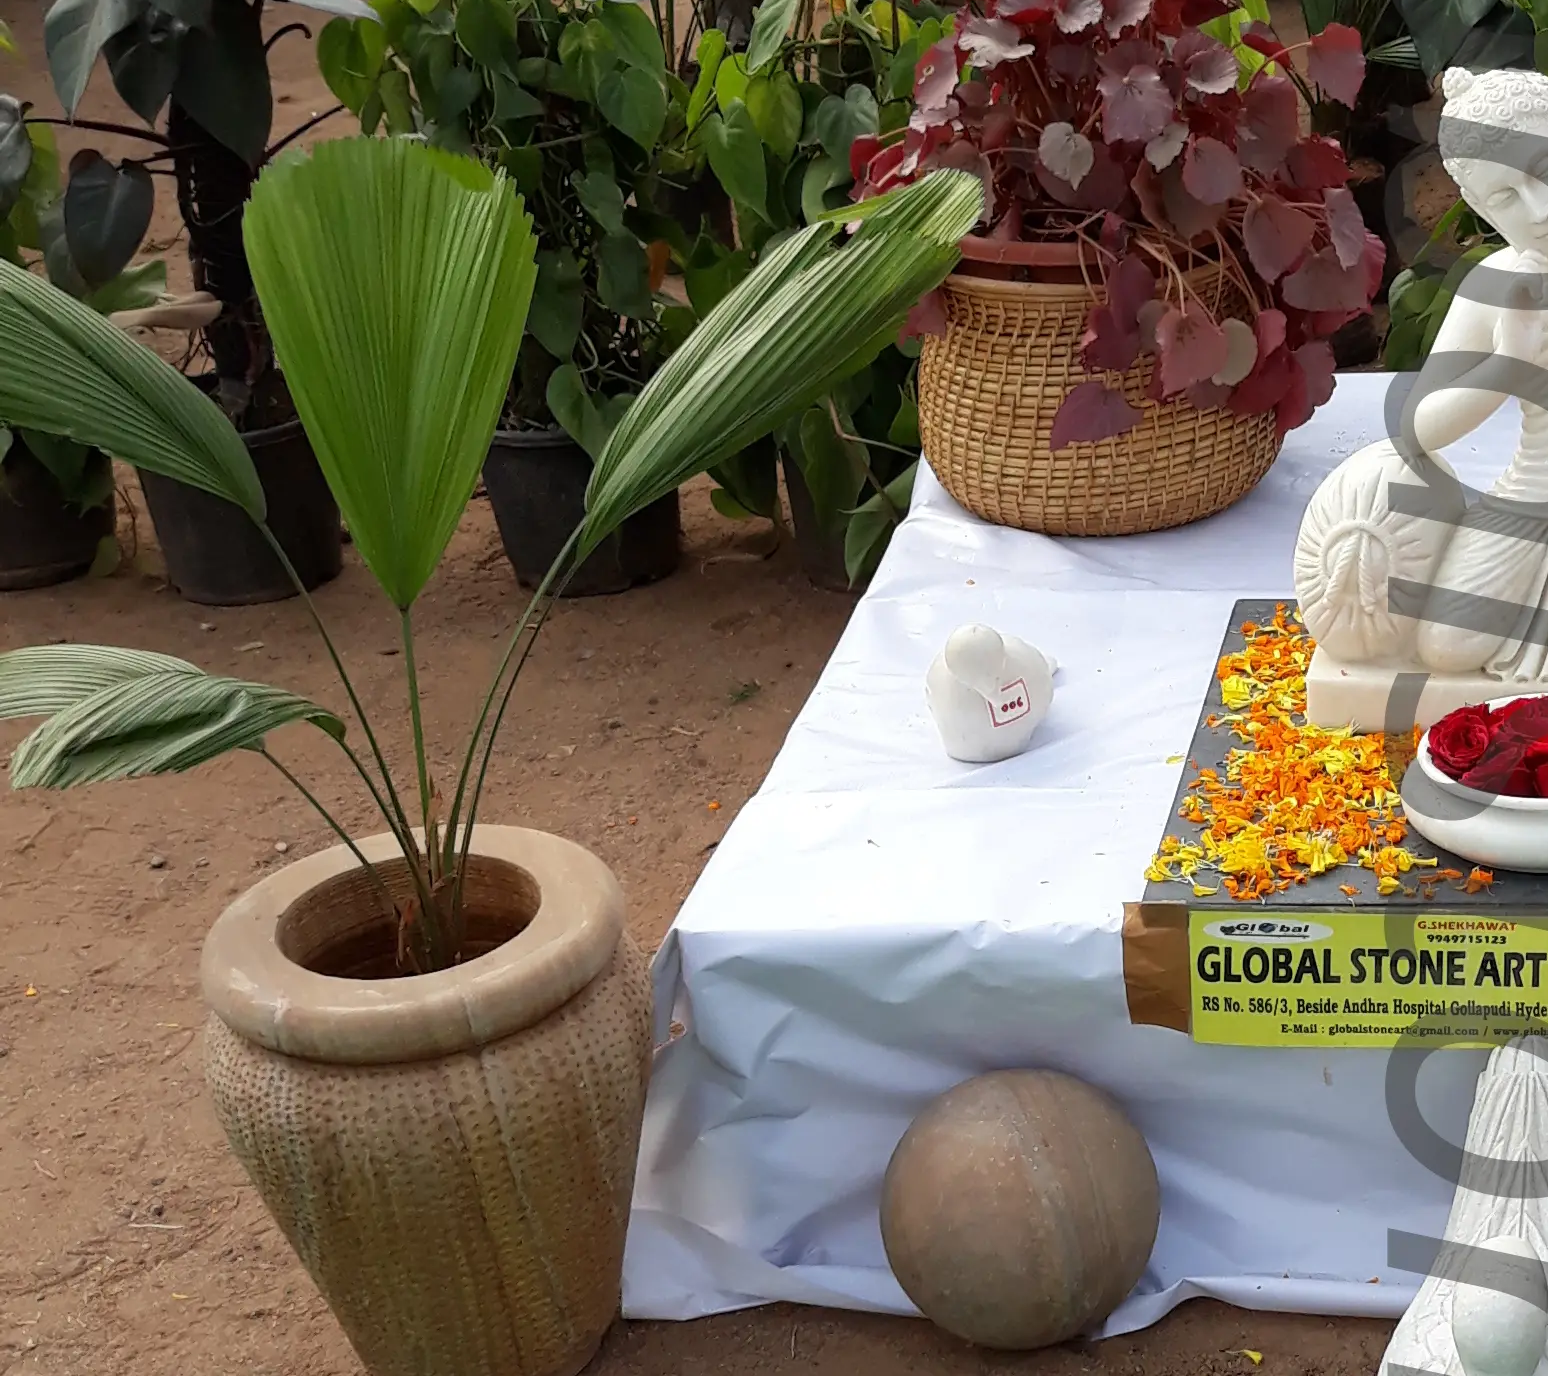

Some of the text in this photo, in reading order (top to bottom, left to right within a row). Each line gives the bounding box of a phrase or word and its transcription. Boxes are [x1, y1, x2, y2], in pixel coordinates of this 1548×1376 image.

[1417, 920, 1517, 931] G.SHEKHAWAT
[1427, 934, 1507, 945] 9949715123
[1197, 945, 1341, 984] GLOBAL
[1350, 947, 1466, 986] STONE
[1473, 950, 1548, 988] ART
[1201, 996, 1220, 1012] RS
[1224, 997, 1244, 1013] No.
[1248, 998, 1293, 1017] 586/3,
[1297, 998, 1339, 1014] Beside
[1342, 999, 1389, 1015] Andhra
[1392, 998, 1447, 1019] Hospital
[1450, 1000, 1512, 1021] Gollapudi
[1280, 1023, 1318, 1035] E-Mail
[1328, 1023, 1479, 1037] globalstoneart@gmail.com
